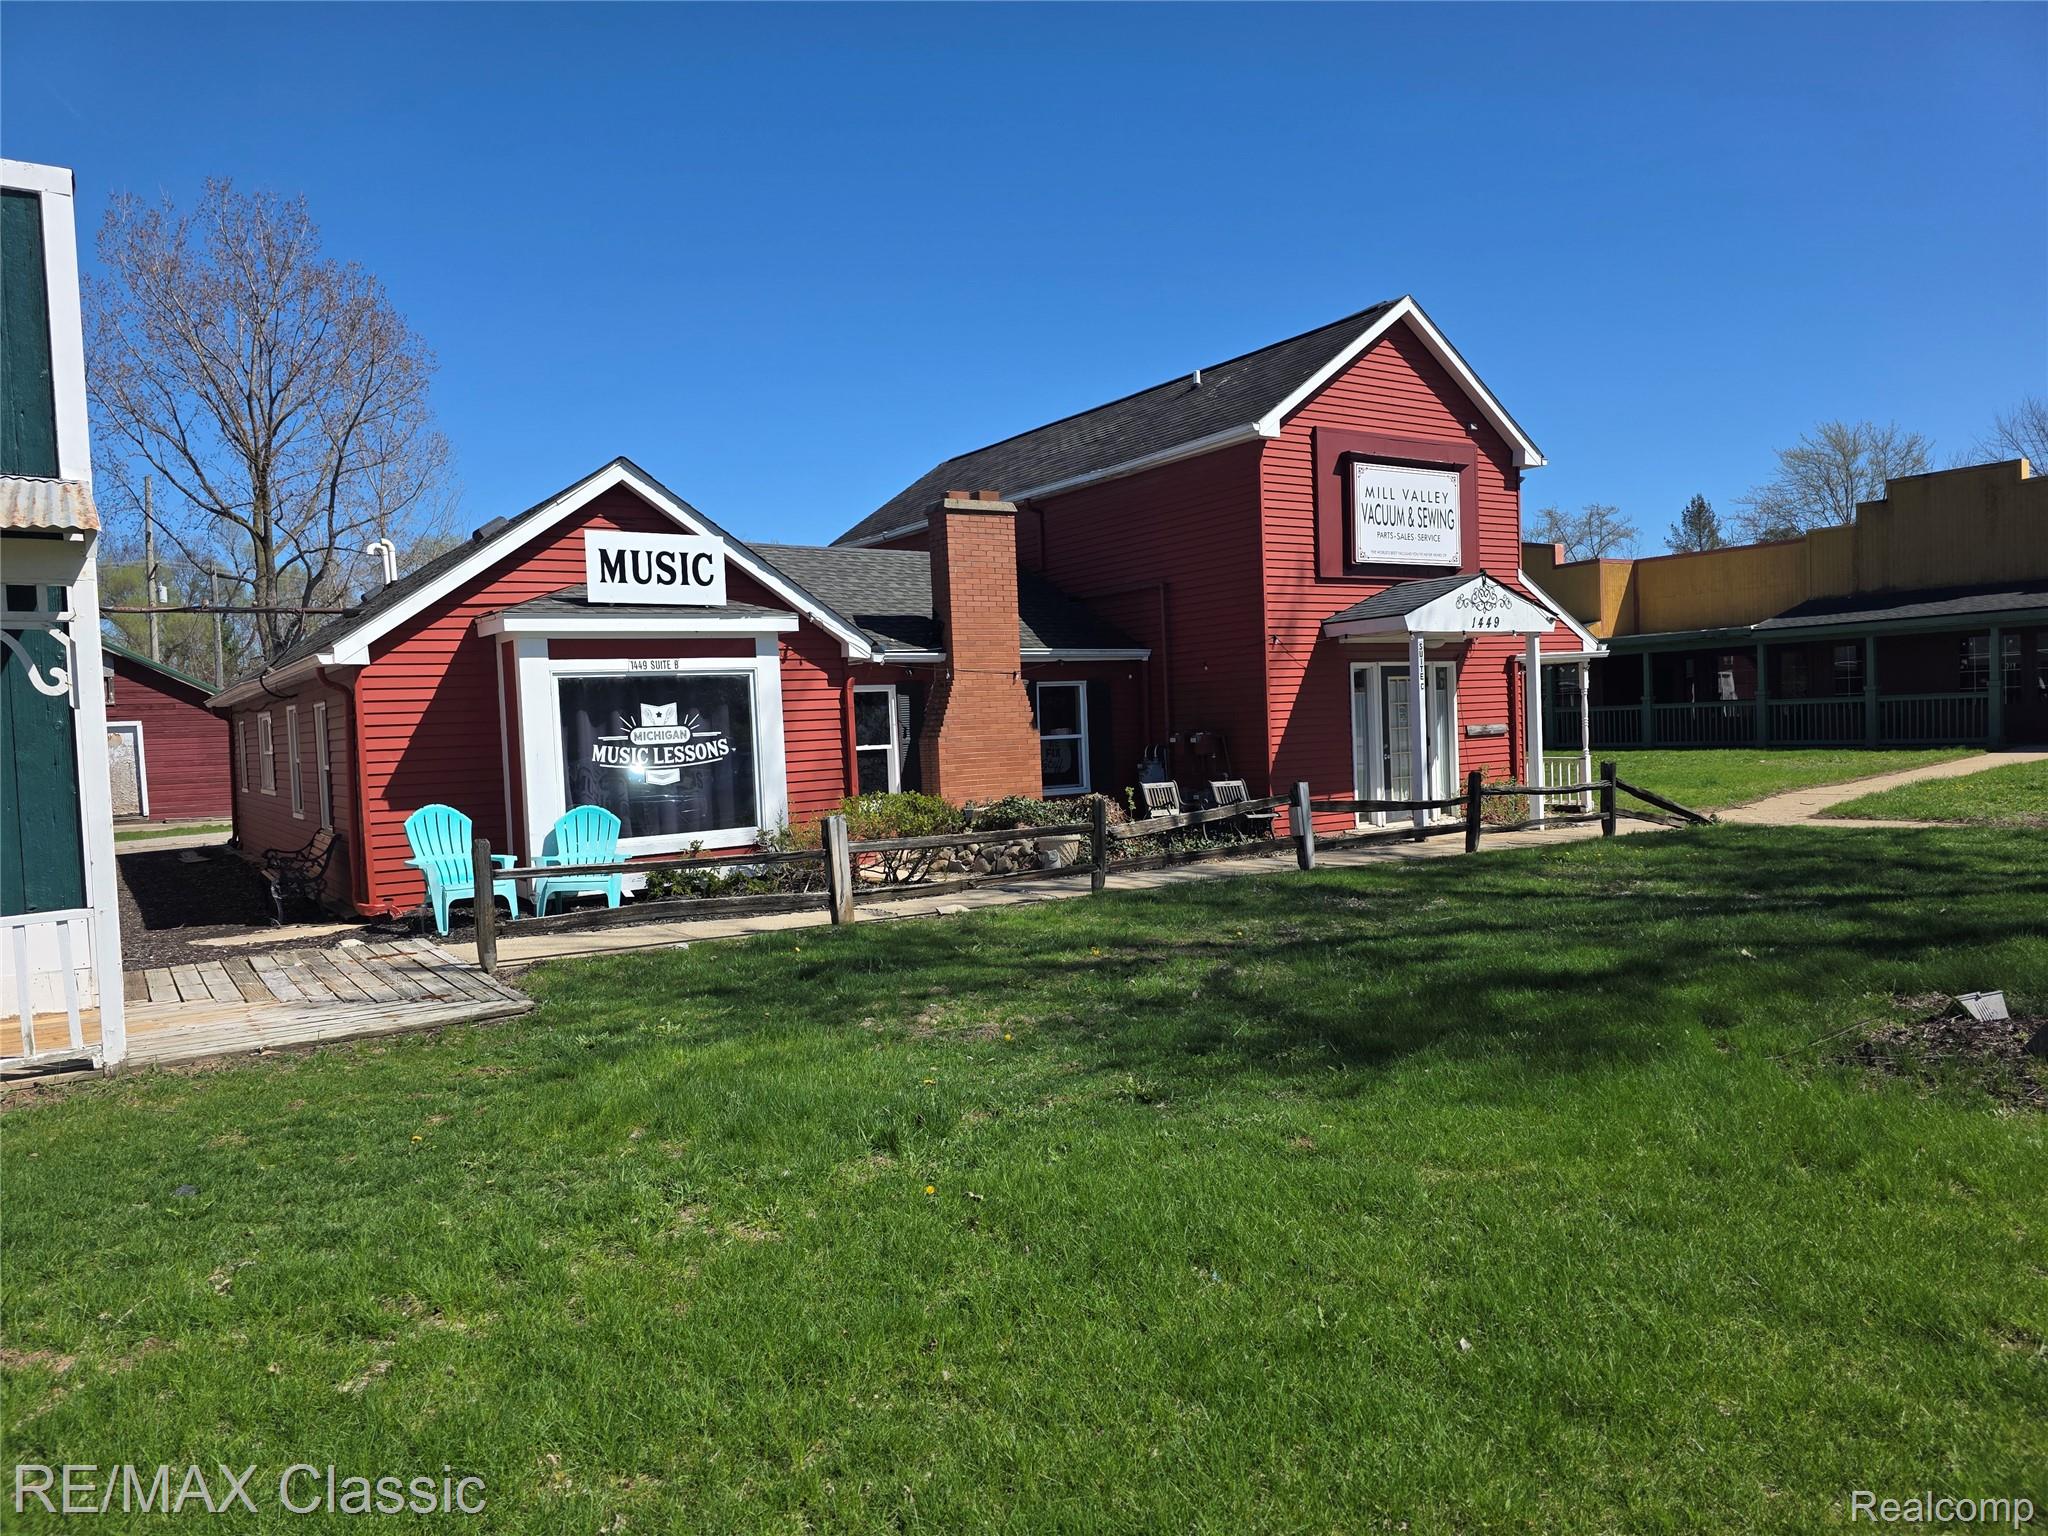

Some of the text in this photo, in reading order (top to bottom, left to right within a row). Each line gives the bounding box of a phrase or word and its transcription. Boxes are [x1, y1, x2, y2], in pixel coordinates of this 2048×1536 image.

[1364, 485, 1449, 504] MILL VALLEY
[1361, 502, 1455, 530] VACUUM & SEWING
[599, 548, 715, 587] MUSIC
[1471, 616, 1501, 629] 1449
[630, 659, 679, 670] 1449 SUITE B
[633, 730, 687, 742] MICHIGAN
[592, 738, 729, 764] MUSIC LESSONS
